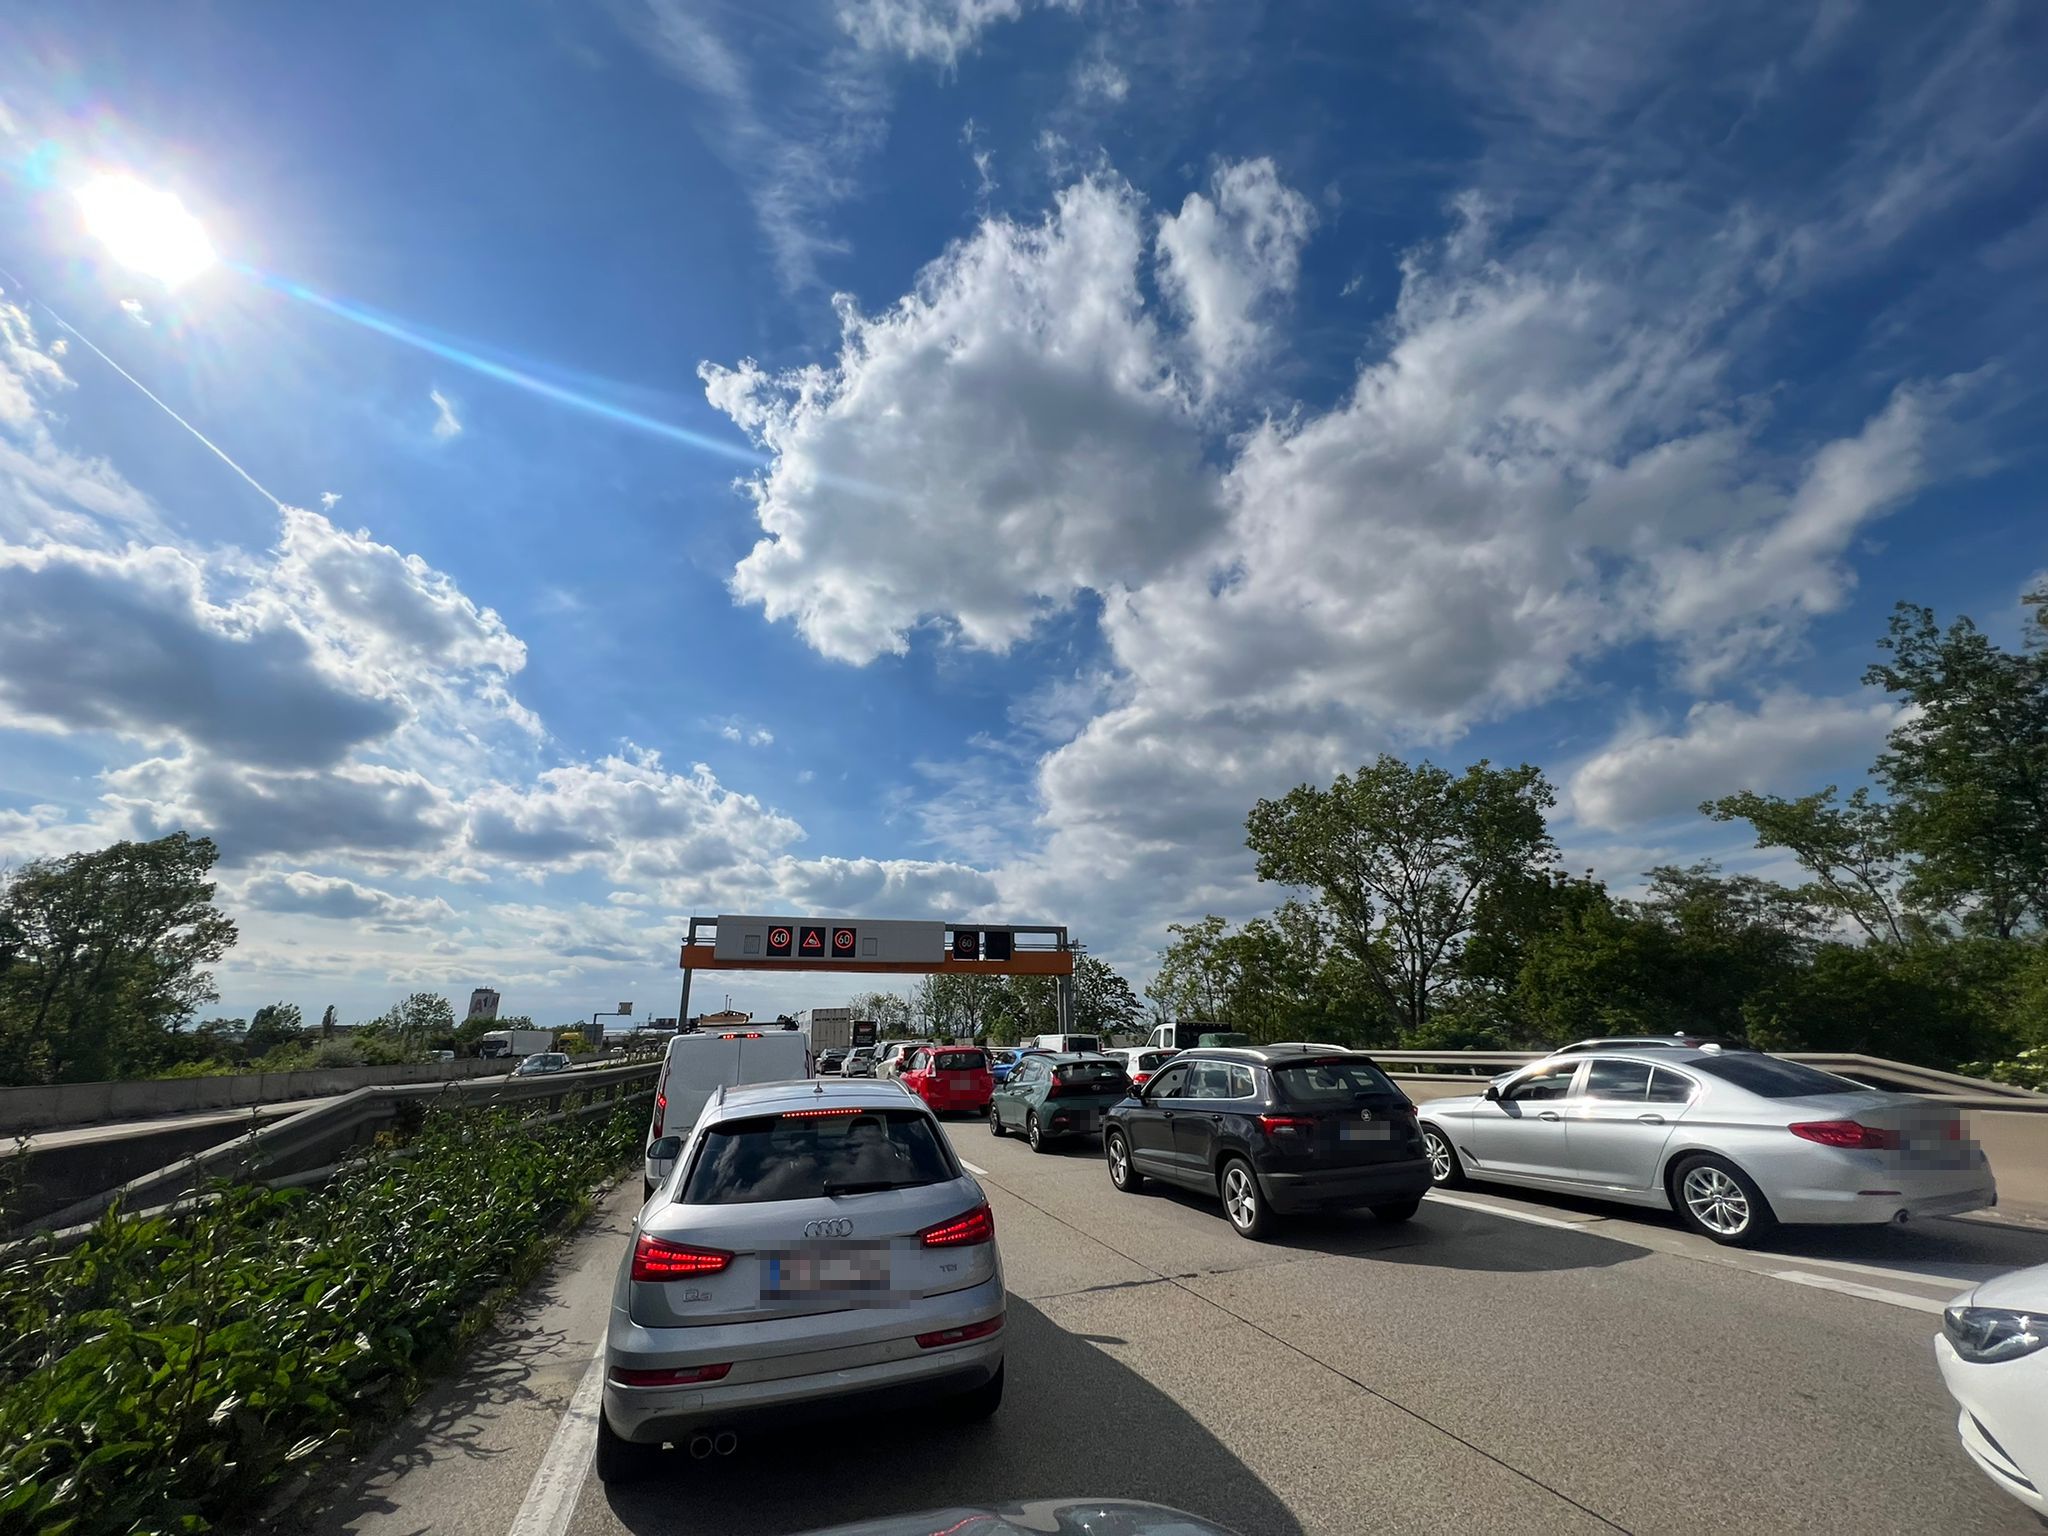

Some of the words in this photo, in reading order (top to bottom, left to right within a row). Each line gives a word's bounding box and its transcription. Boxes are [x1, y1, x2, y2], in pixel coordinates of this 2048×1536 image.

[774, 933, 787, 943] 60
[838, 935, 850, 944] 60
[961, 939, 972, 948] 60
